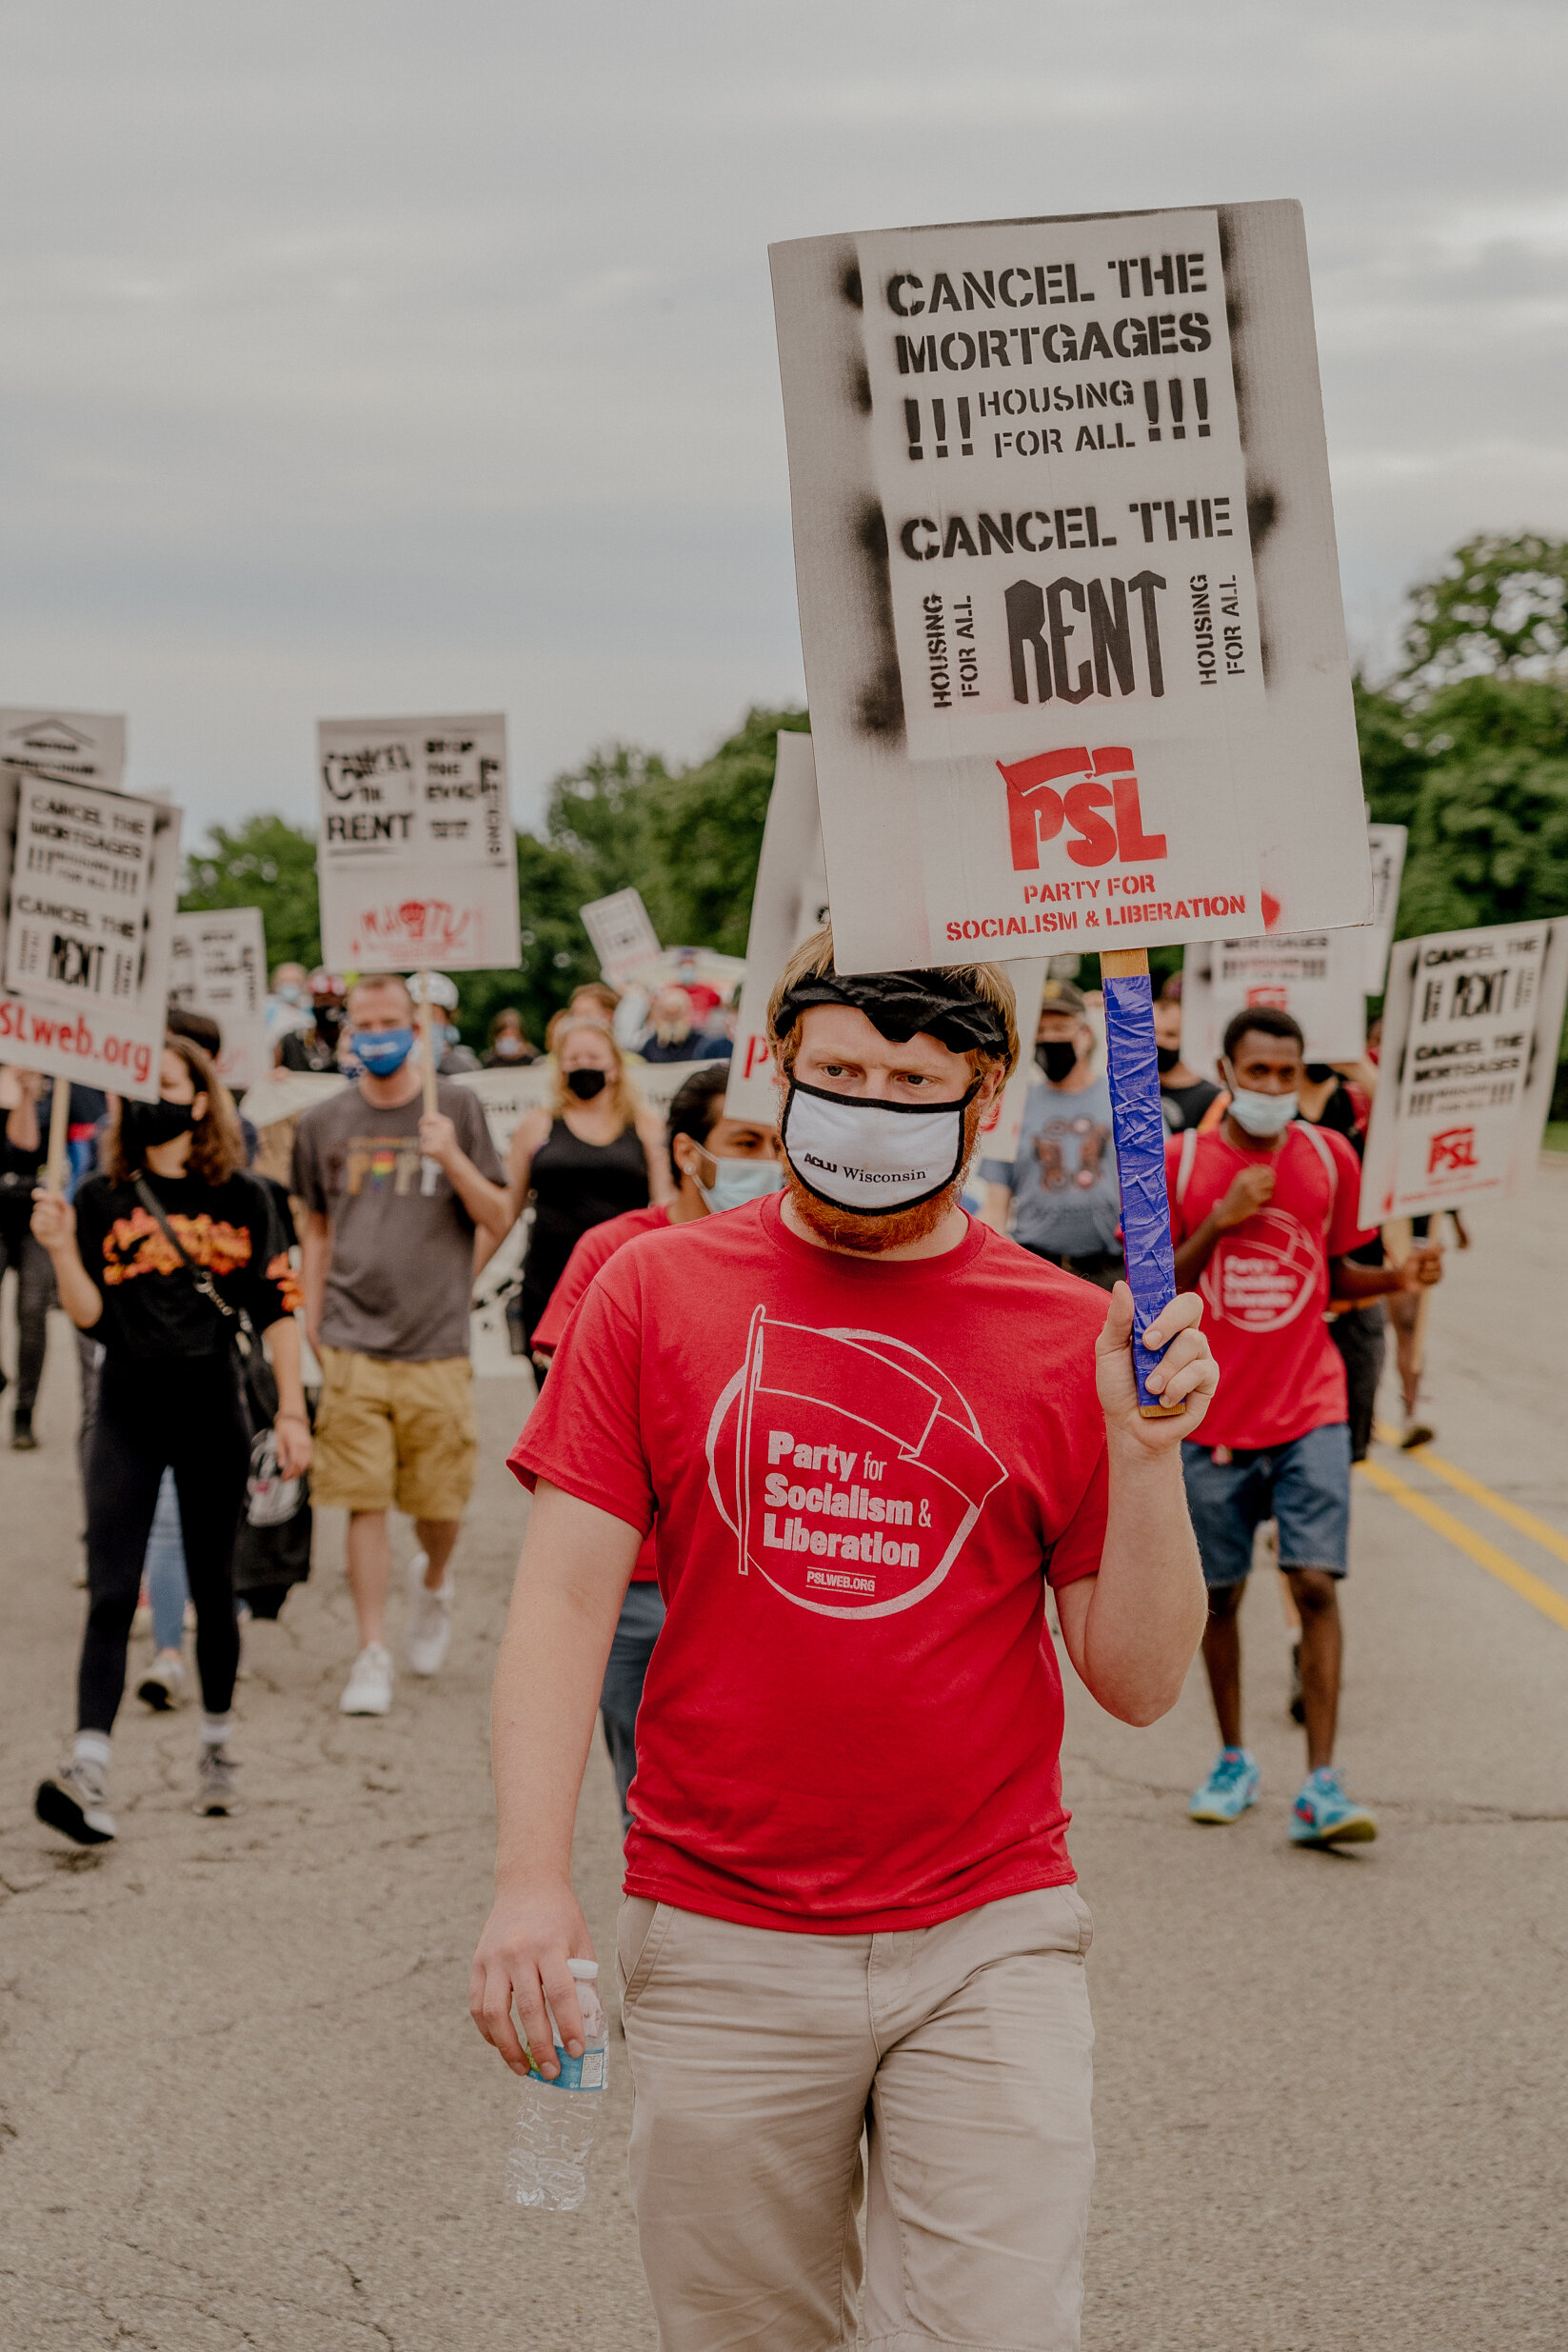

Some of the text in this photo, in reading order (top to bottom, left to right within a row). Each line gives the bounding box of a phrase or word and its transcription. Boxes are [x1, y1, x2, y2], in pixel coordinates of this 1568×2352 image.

[887, 253, 1207, 317] CANCEL THE
[897, 312, 1212, 374] MORTGAGES
[979, 379, 1135, 417] HOUSING
[995, 423, 1136, 458] FOR ALL
[901, 497, 1233, 561] CANCEL THE
[923, 594, 952, 708] HOUSING
[954, 596, 980, 697] FOR ALL
[1004, 570, 1166, 705] RENT
[1190, 573, 1218, 685] HOUSING
[1220, 574, 1245, 674] FOR ALL
[328, 813, 412, 842] RENT
[1004, 773, 1167, 870] PSL
[1022, 874, 1156, 905] PARTY FOR
[946, 895, 1245, 942] SOCIALISM & LIBERATION
[804, 1153, 926, 1183] ACLU Wisconsin
[1427, 1137, 1478, 1173] PSL
[767, 1430, 887, 1482] Party for
[764, 1473, 932, 1527] Socialism &
[763, 1513, 920, 1567] Liberation
[807, 1570, 876, 1592] PSLWEB.ORG
